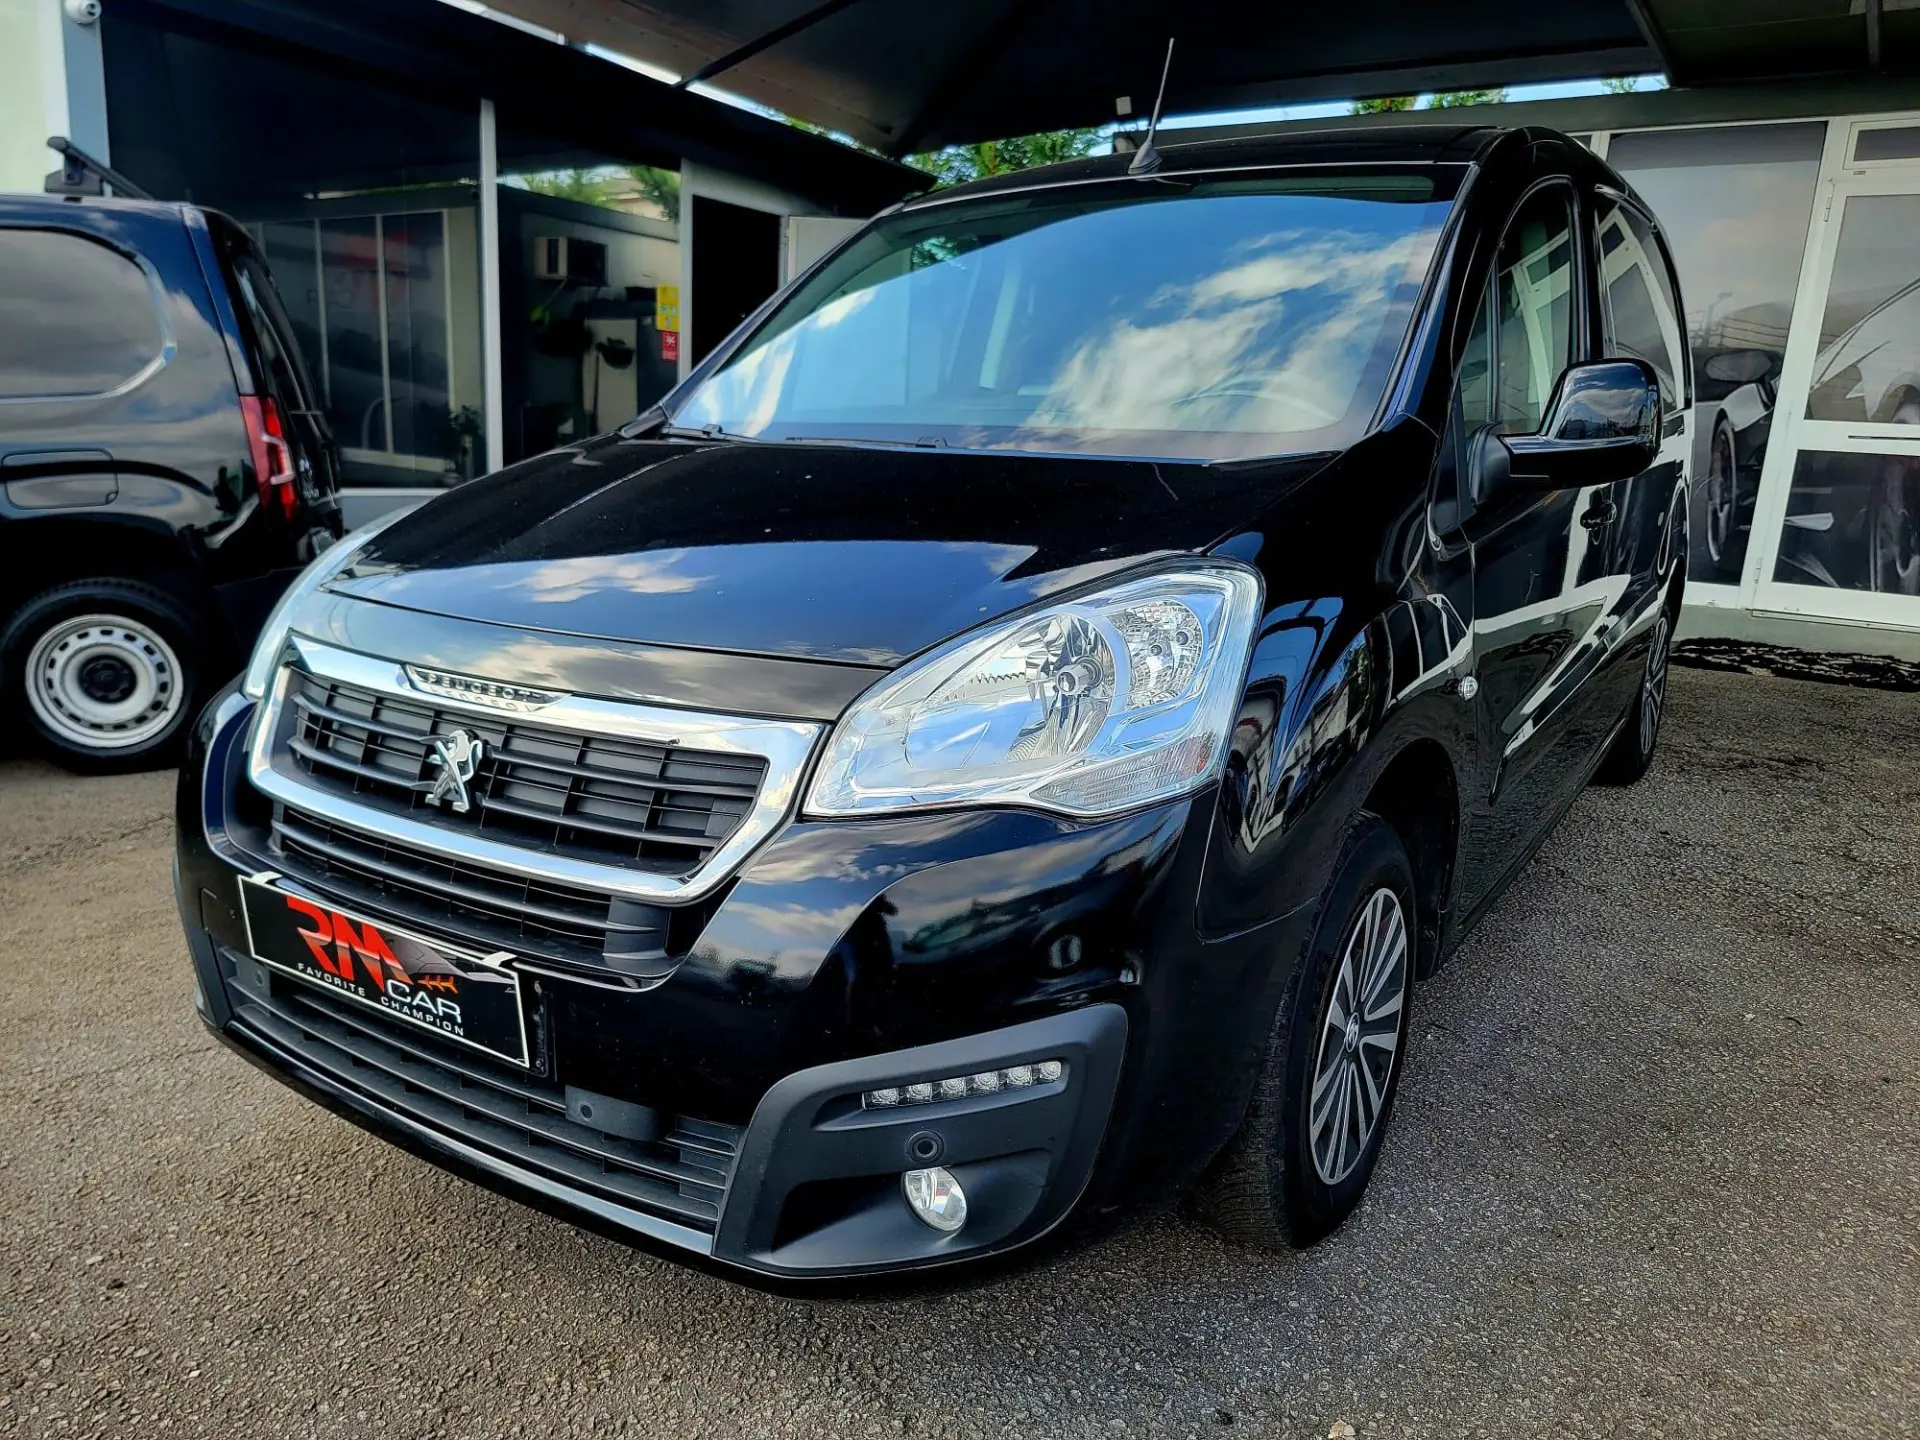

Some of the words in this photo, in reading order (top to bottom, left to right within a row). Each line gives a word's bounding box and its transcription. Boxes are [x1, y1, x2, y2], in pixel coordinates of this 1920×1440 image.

[426, 672, 531, 702] PEUGEOT
[297, 962, 366, 998] FAVORITE
[380, 996, 465, 1037] CHAMPION
[387, 978, 462, 1024] CAR
